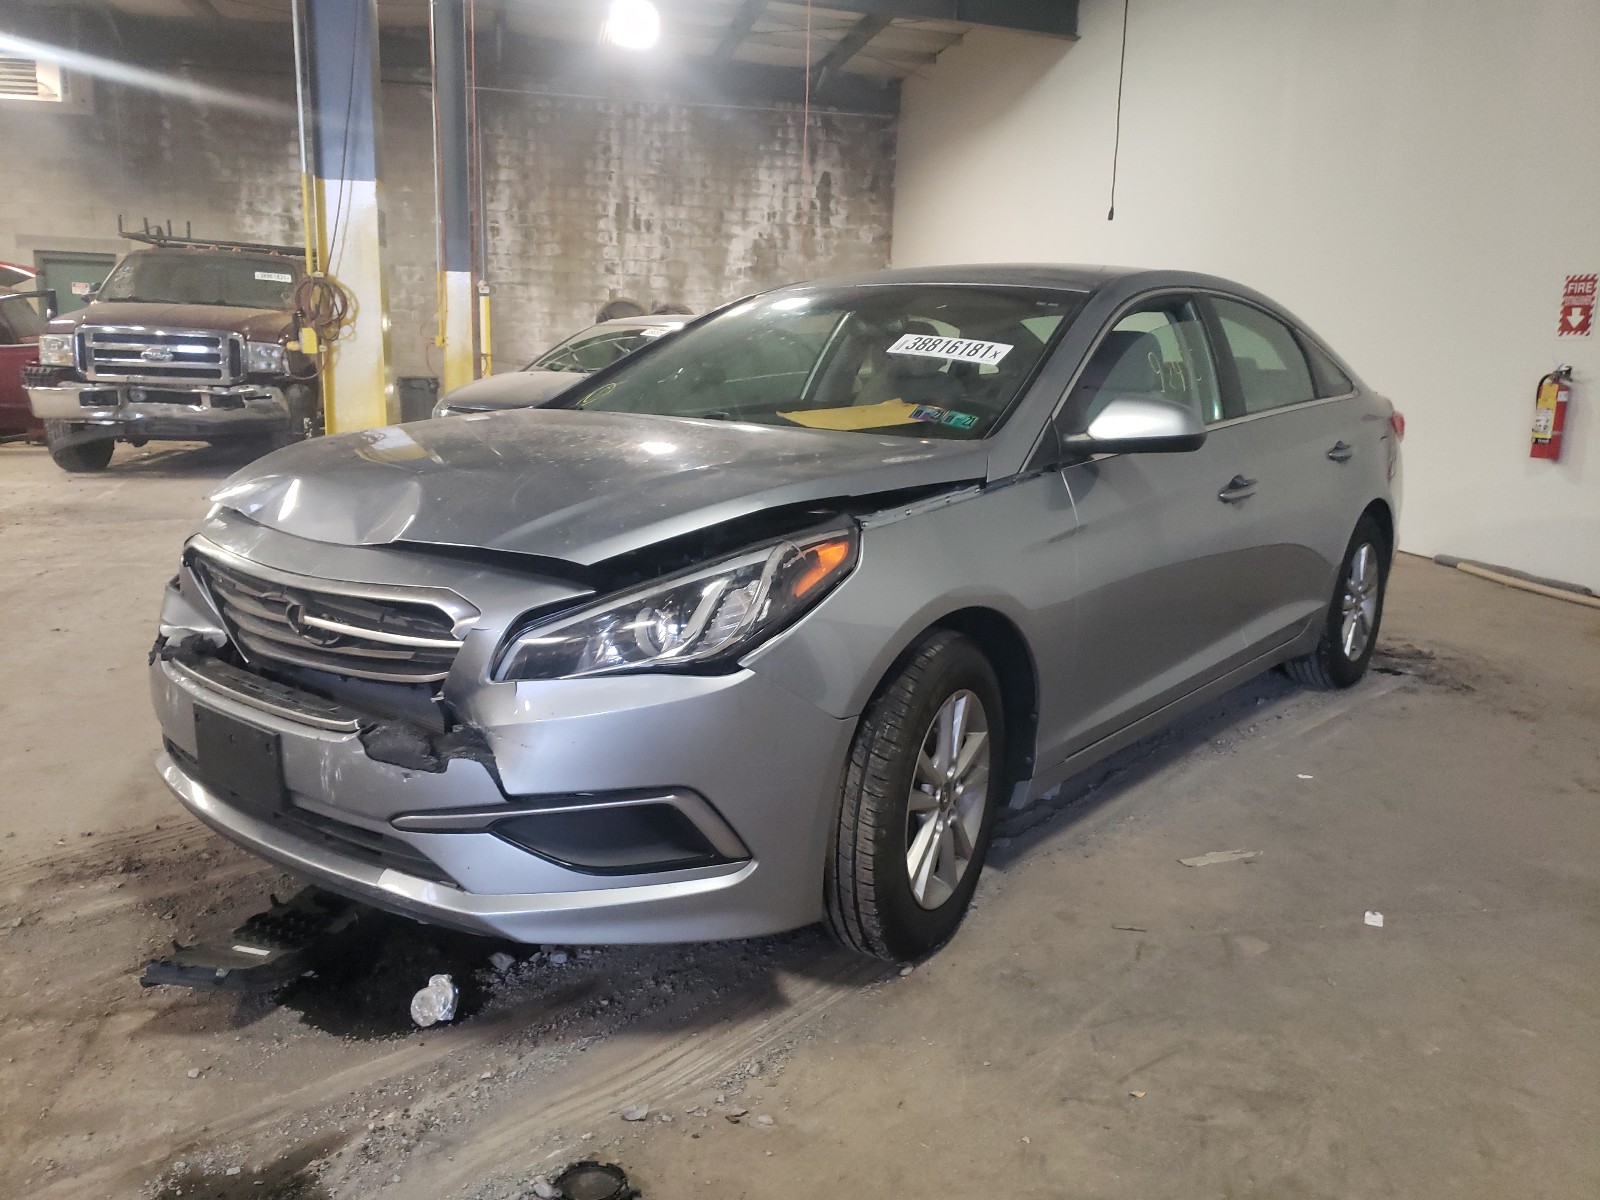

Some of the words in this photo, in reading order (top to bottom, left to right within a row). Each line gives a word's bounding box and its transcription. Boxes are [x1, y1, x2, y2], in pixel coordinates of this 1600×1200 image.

[1567, 282, 1593, 294] FIRE
[904, 337, 995, 358] 38816181
[962, 416, 976, 427] 21
